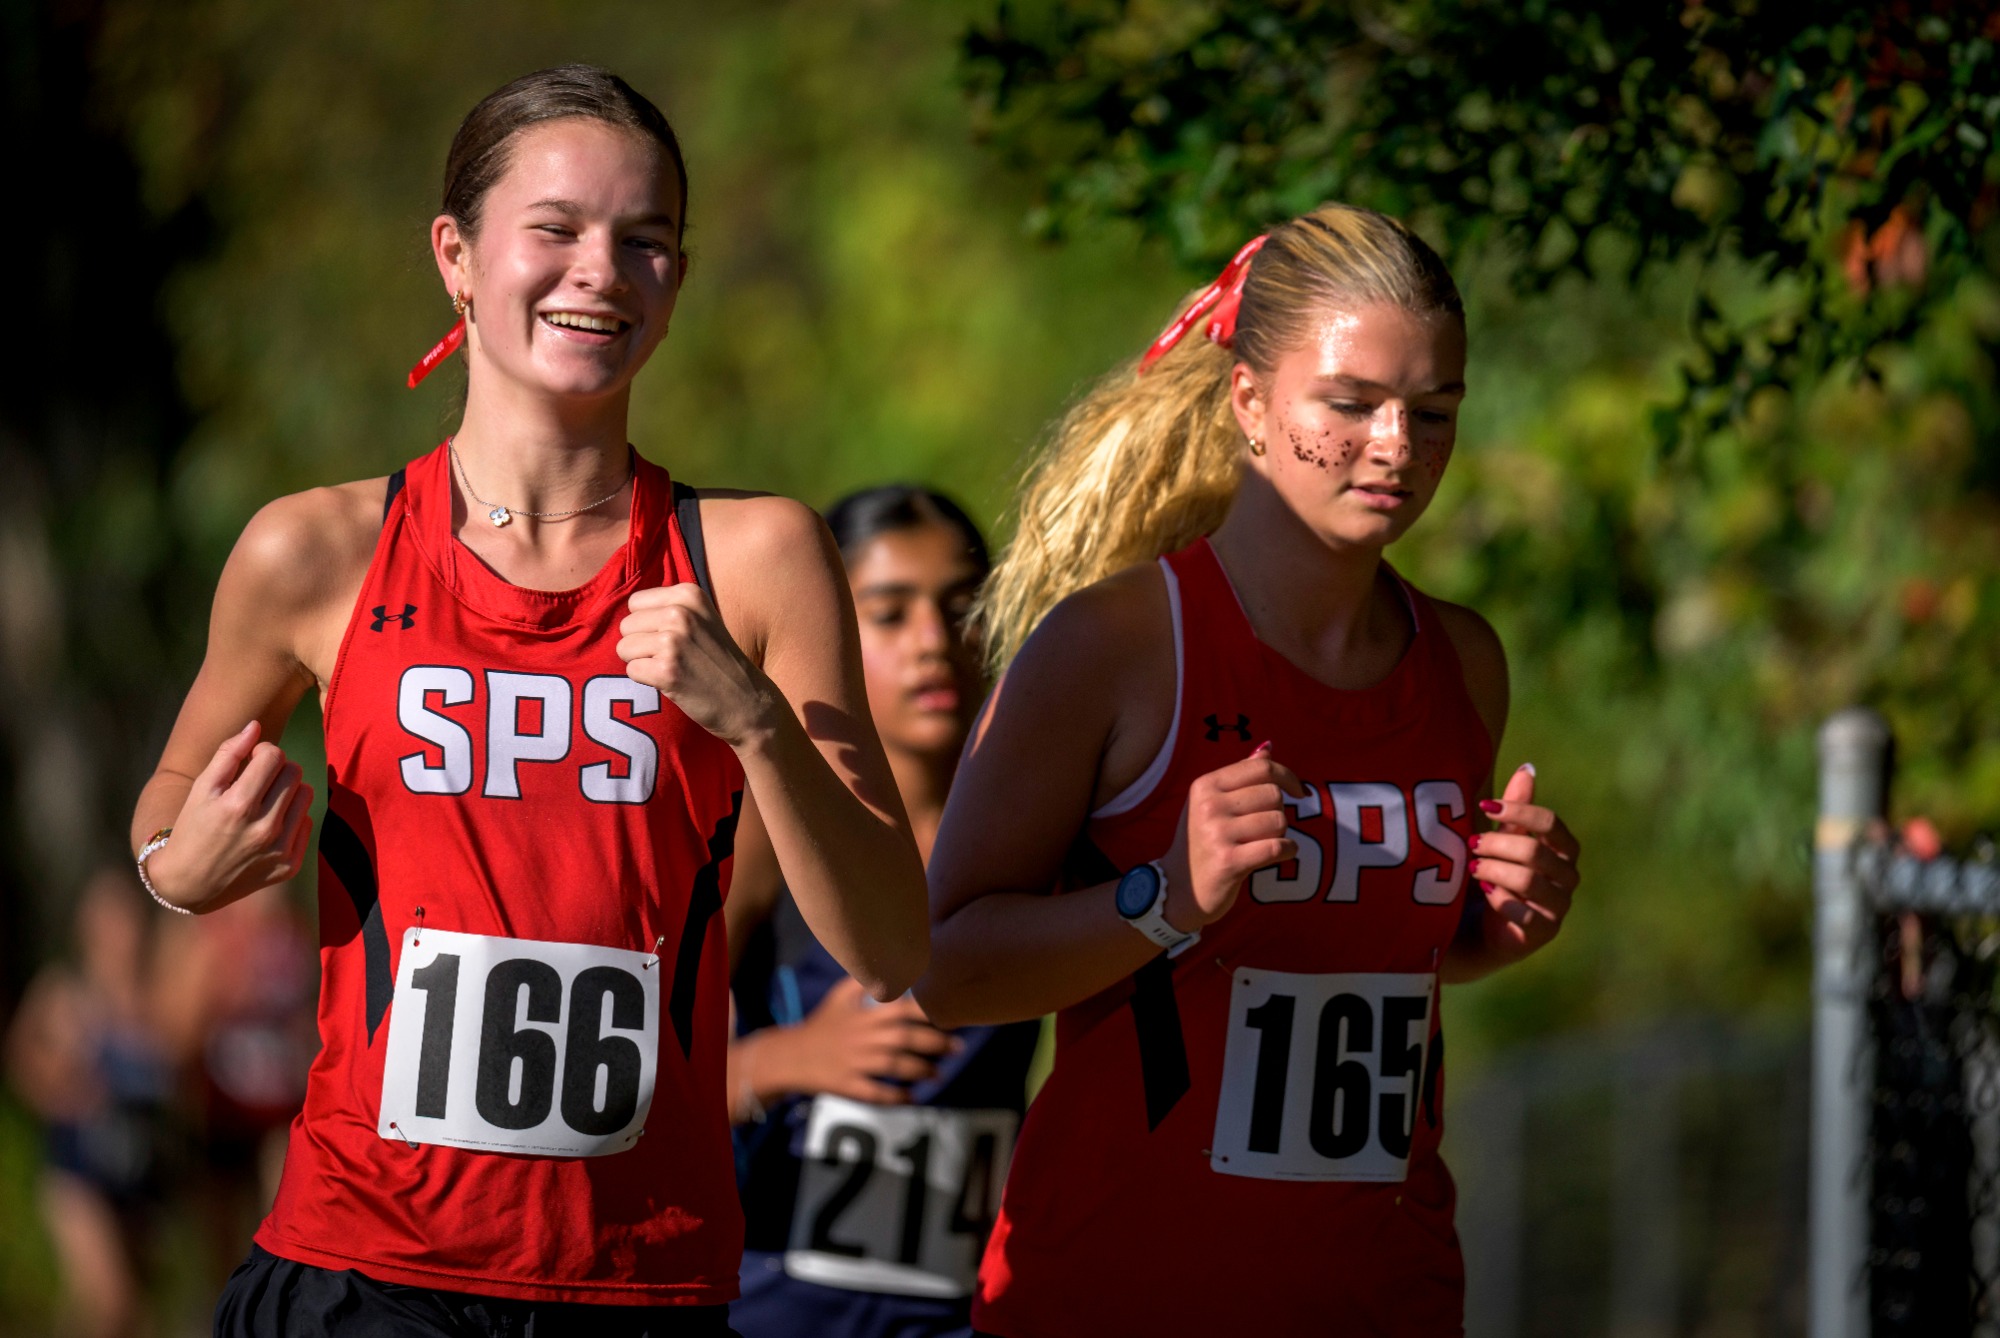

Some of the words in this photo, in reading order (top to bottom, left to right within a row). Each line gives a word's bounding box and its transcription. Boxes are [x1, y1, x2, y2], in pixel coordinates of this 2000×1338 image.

[397, 664, 662, 806] SPS
[1249, 780, 1467, 906] SPS
[411, 953, 645, 1136] 166
[1245, 993, 1428, 1159] 165
[811, 1122, 997, 1270] 214
